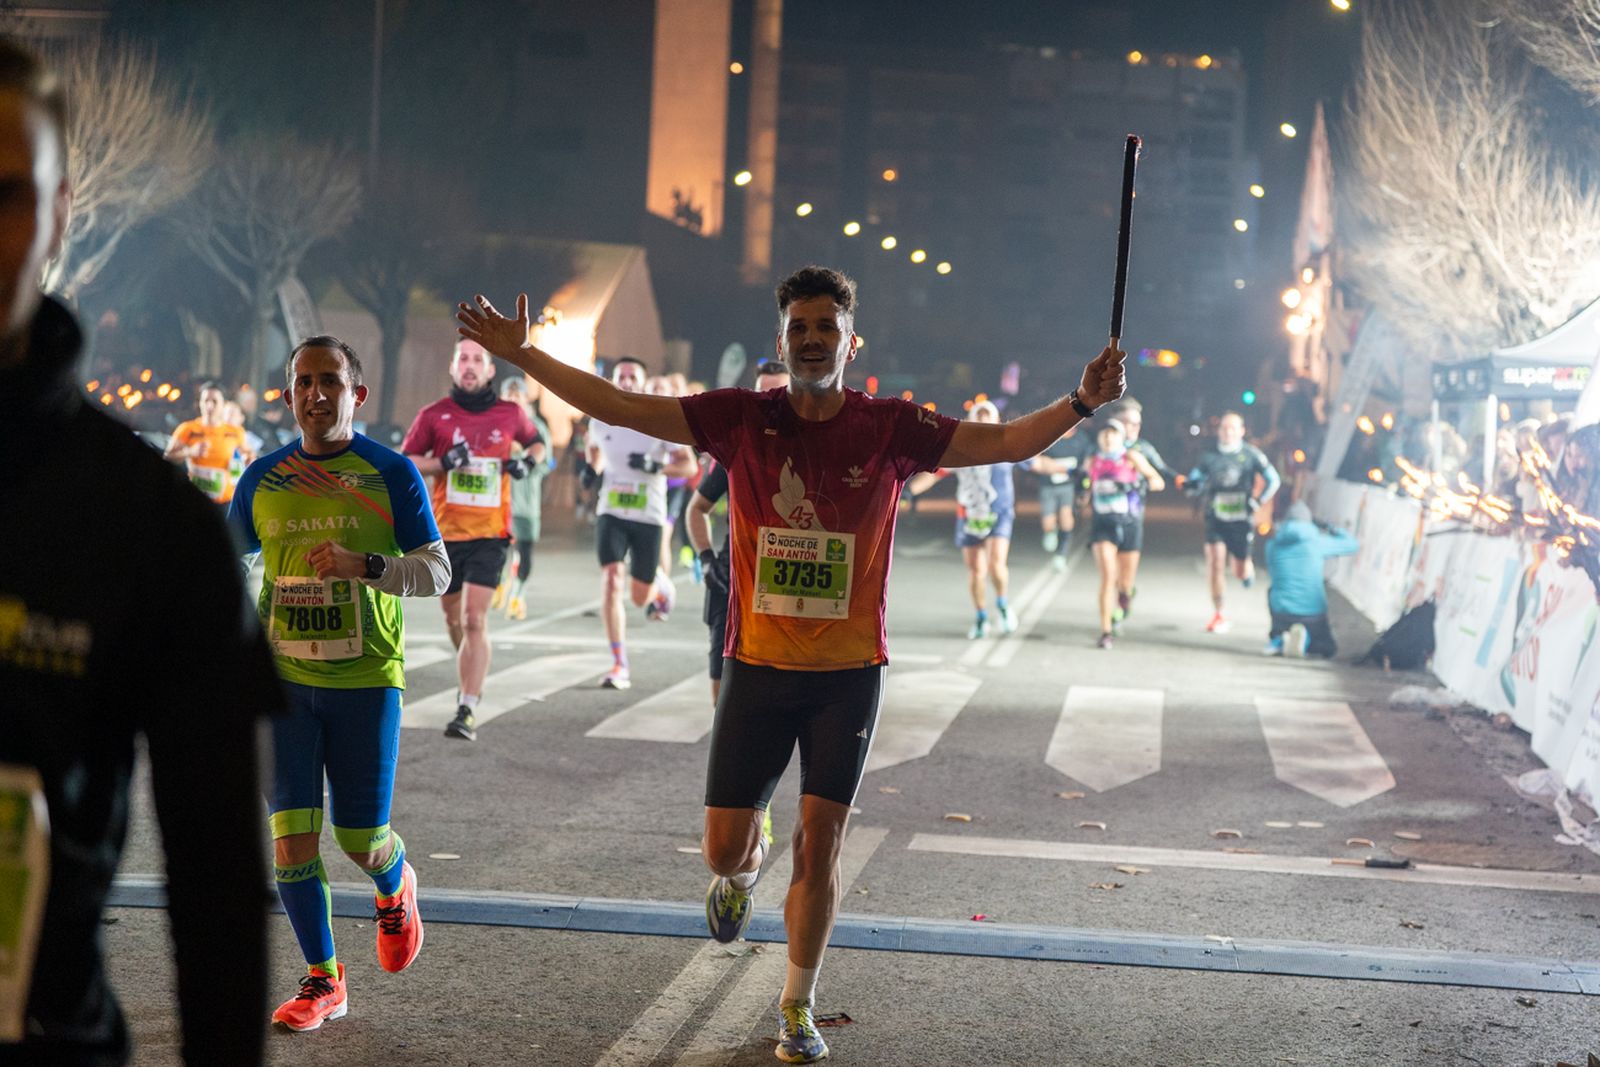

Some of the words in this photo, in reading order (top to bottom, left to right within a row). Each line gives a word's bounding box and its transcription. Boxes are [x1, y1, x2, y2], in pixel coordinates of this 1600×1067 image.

[789, 506, 814, 529] 43
[287, 517, 359, 532] SAKATA
[777, 538, 805, 549] NOCHE
[807, 540, 818, 550] DE
[767, 547, 784, 557] SAN
[774, 560, 832, 589] 3735
[288, 586, 311, 595] NOCHE
[313, 586, 323, 594] DE
[280, 595, 296, 605] SAN
[285, 606, 342, 632] 7808
